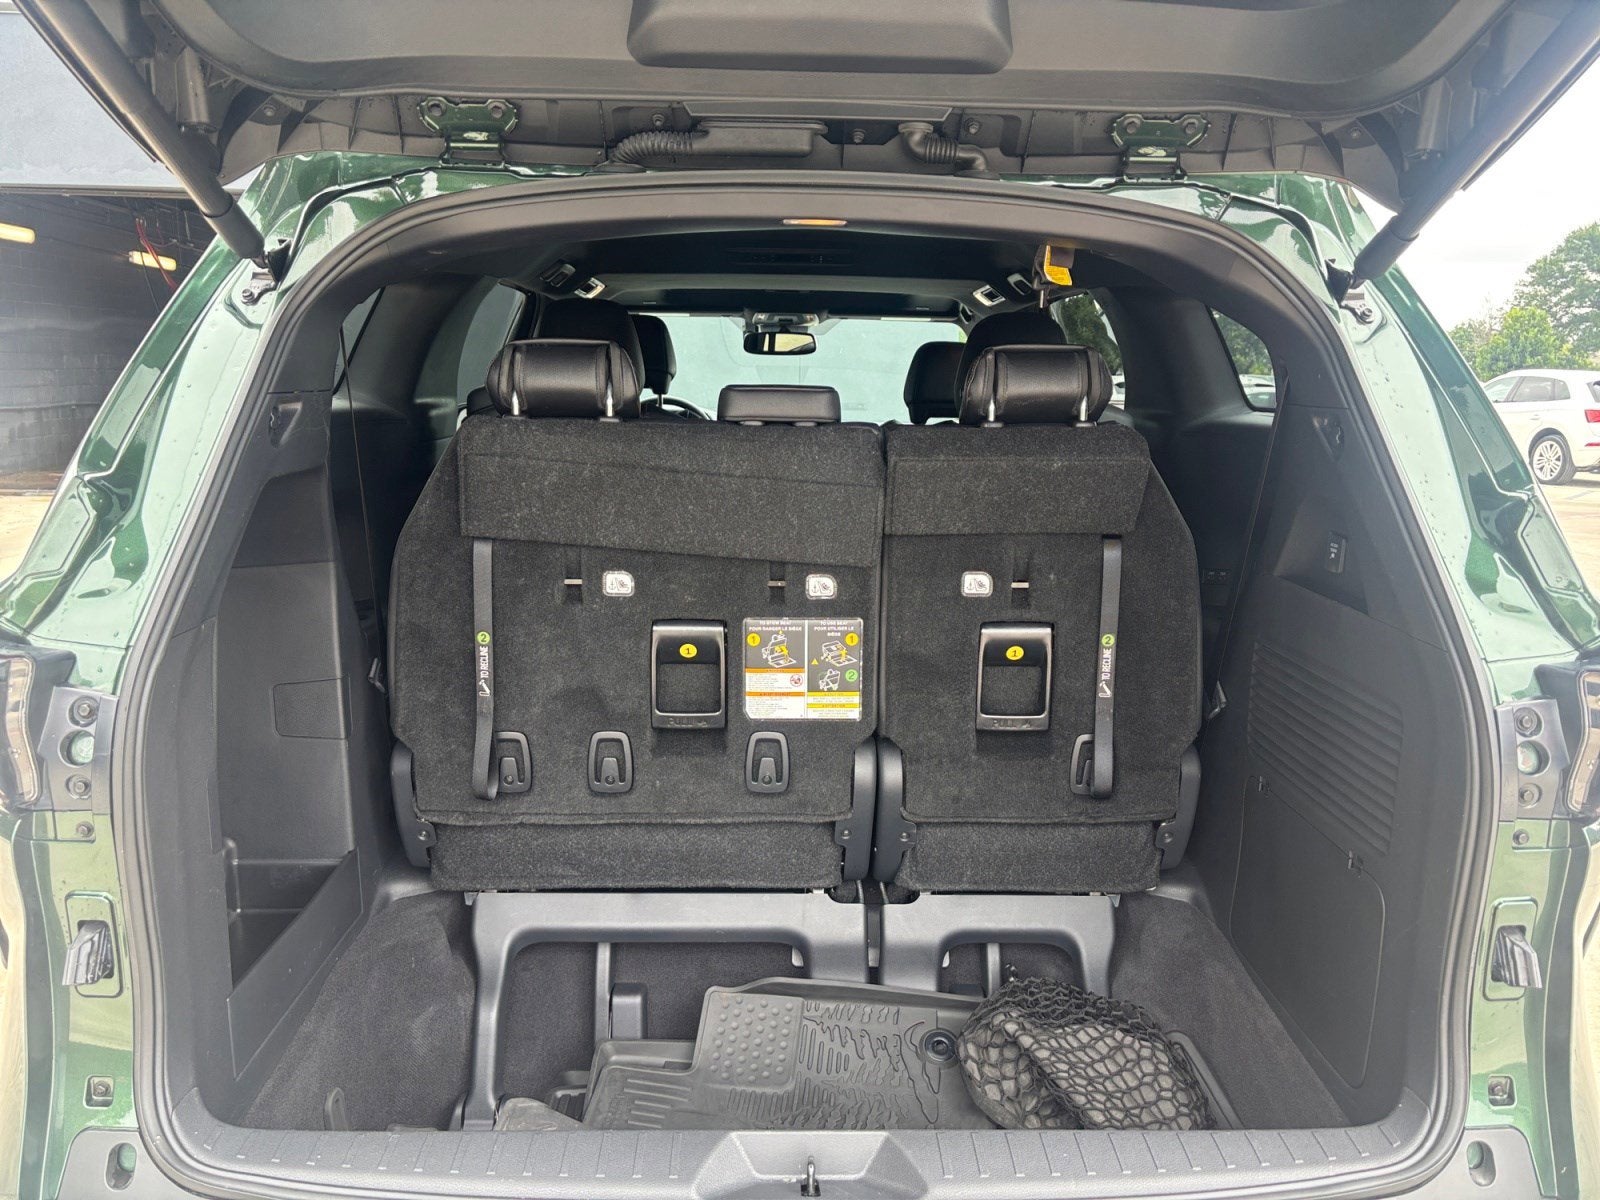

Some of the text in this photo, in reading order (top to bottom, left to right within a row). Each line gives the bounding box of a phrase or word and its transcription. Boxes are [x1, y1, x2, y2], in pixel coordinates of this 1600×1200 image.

[479, 645, 489, 678] TO RECLINE
[1101, 648, 1112, 681] TO RECLINE
